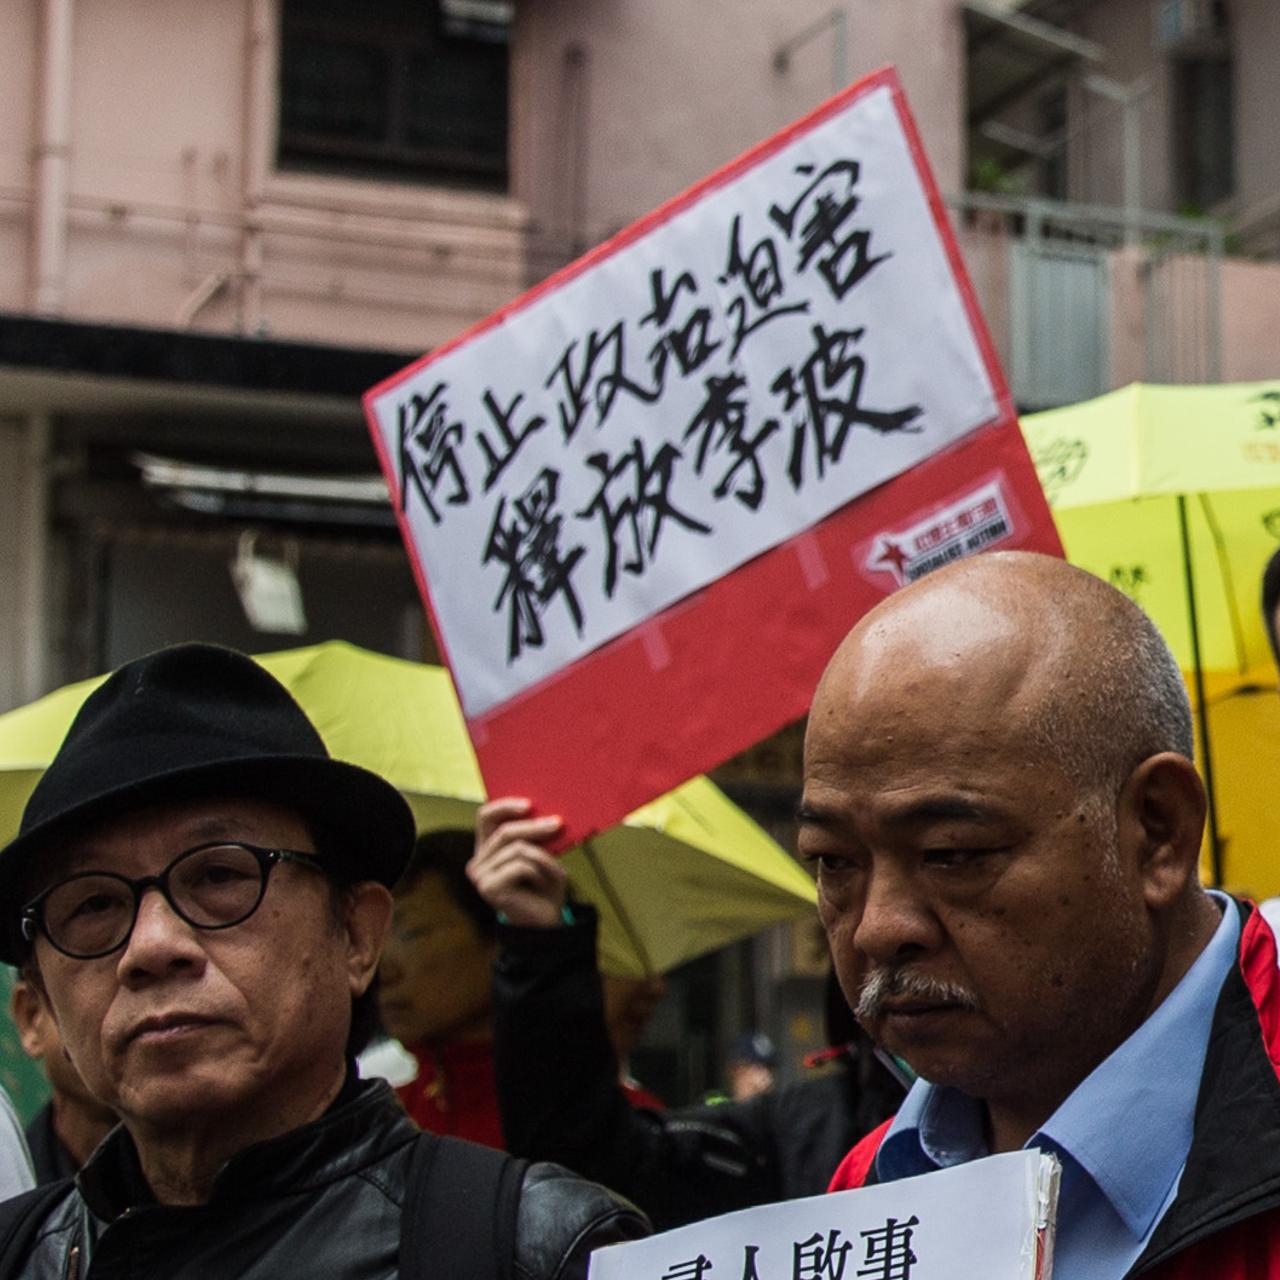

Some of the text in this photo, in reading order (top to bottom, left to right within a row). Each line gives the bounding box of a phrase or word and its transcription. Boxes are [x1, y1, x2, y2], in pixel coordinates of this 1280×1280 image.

[397, 159, 893, 524] 停止政治迫害
[483, 324, 924, 663] 釋放李波
